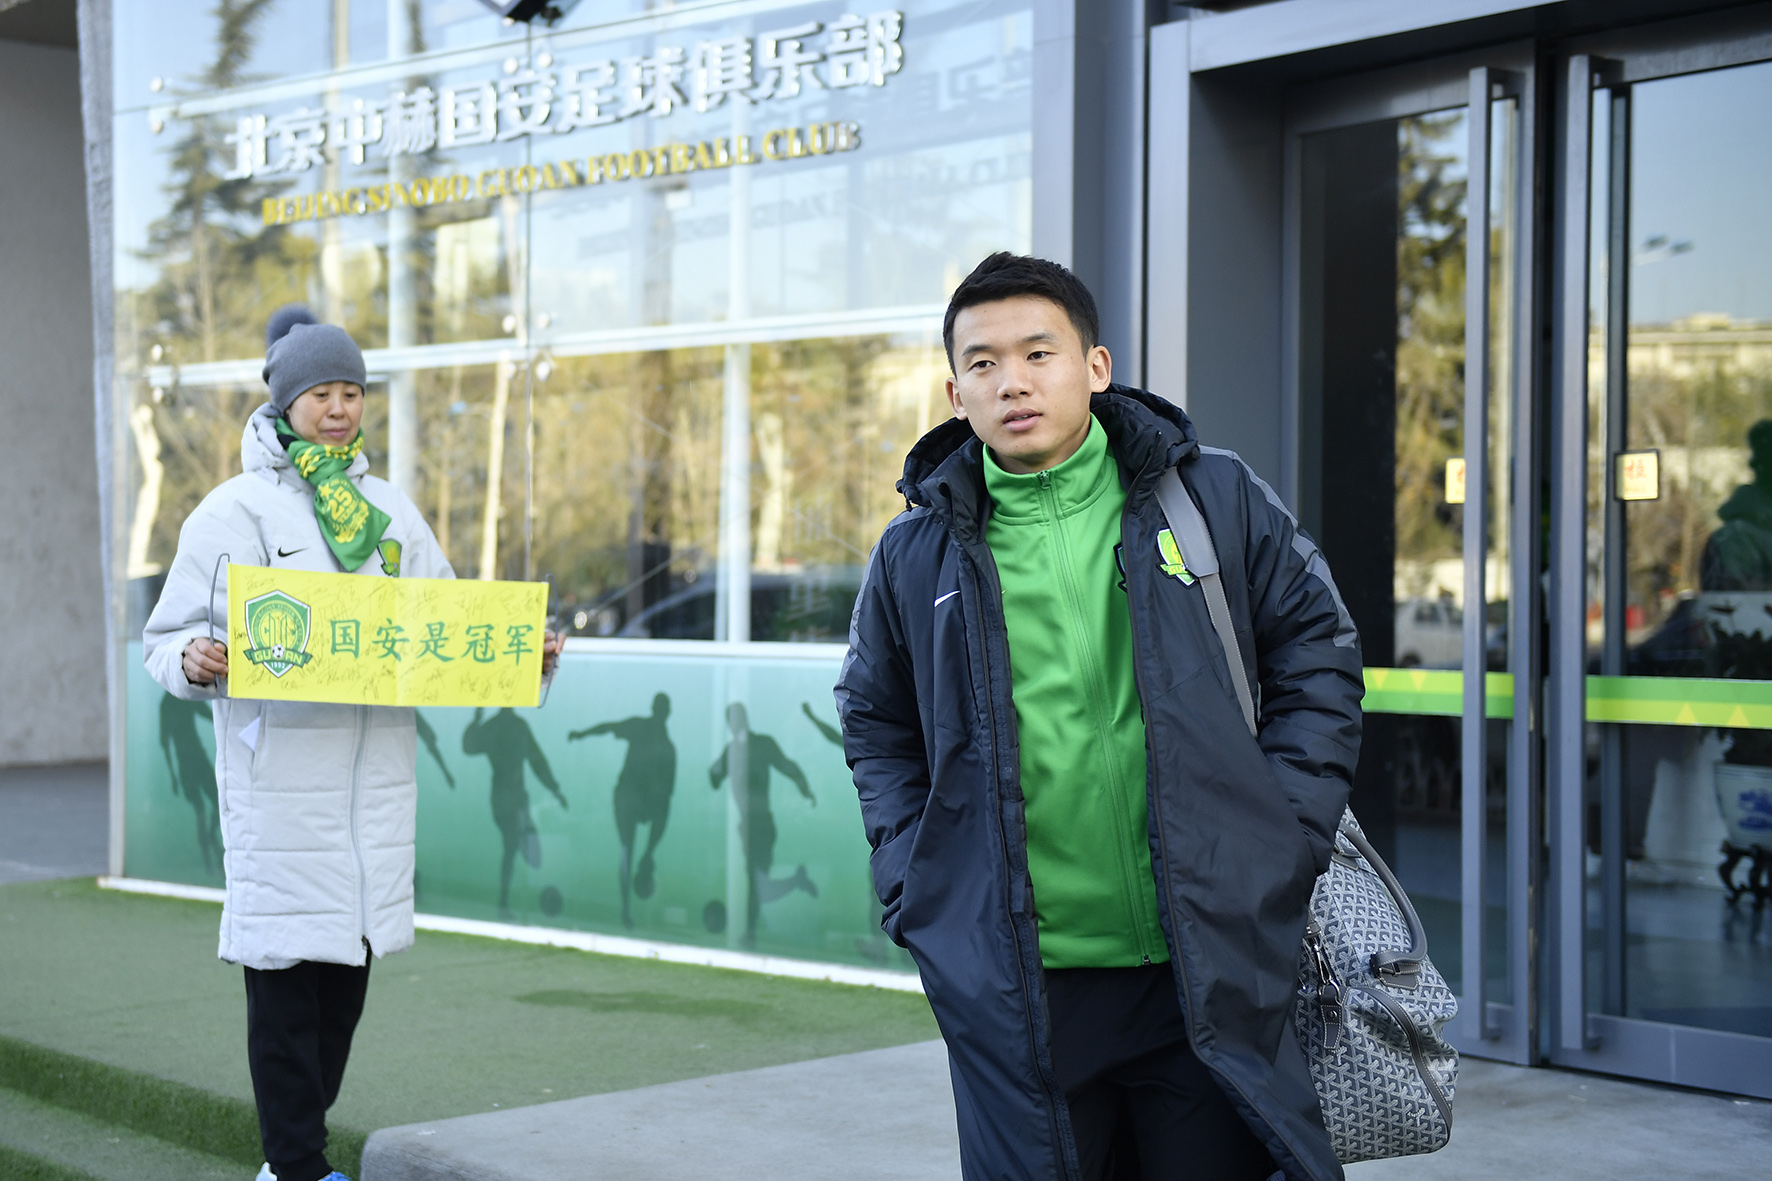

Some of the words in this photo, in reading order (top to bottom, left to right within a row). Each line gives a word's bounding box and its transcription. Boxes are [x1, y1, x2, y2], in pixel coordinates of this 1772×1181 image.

[223, 10, 903, 180] 北京中赫国安足球俱乐部
[261, 188, 361, 226] BEIJING
[364, 174, 470, 213] SINOBO
[475, 158, 581, 199] GUOAN
[586, 136, 761, 185] FOOTBALL
[762, 121, 861, 161] CLUB
[329, 486, 353, 521] 25
[330, 618, 535, 667] 国安是冠军
